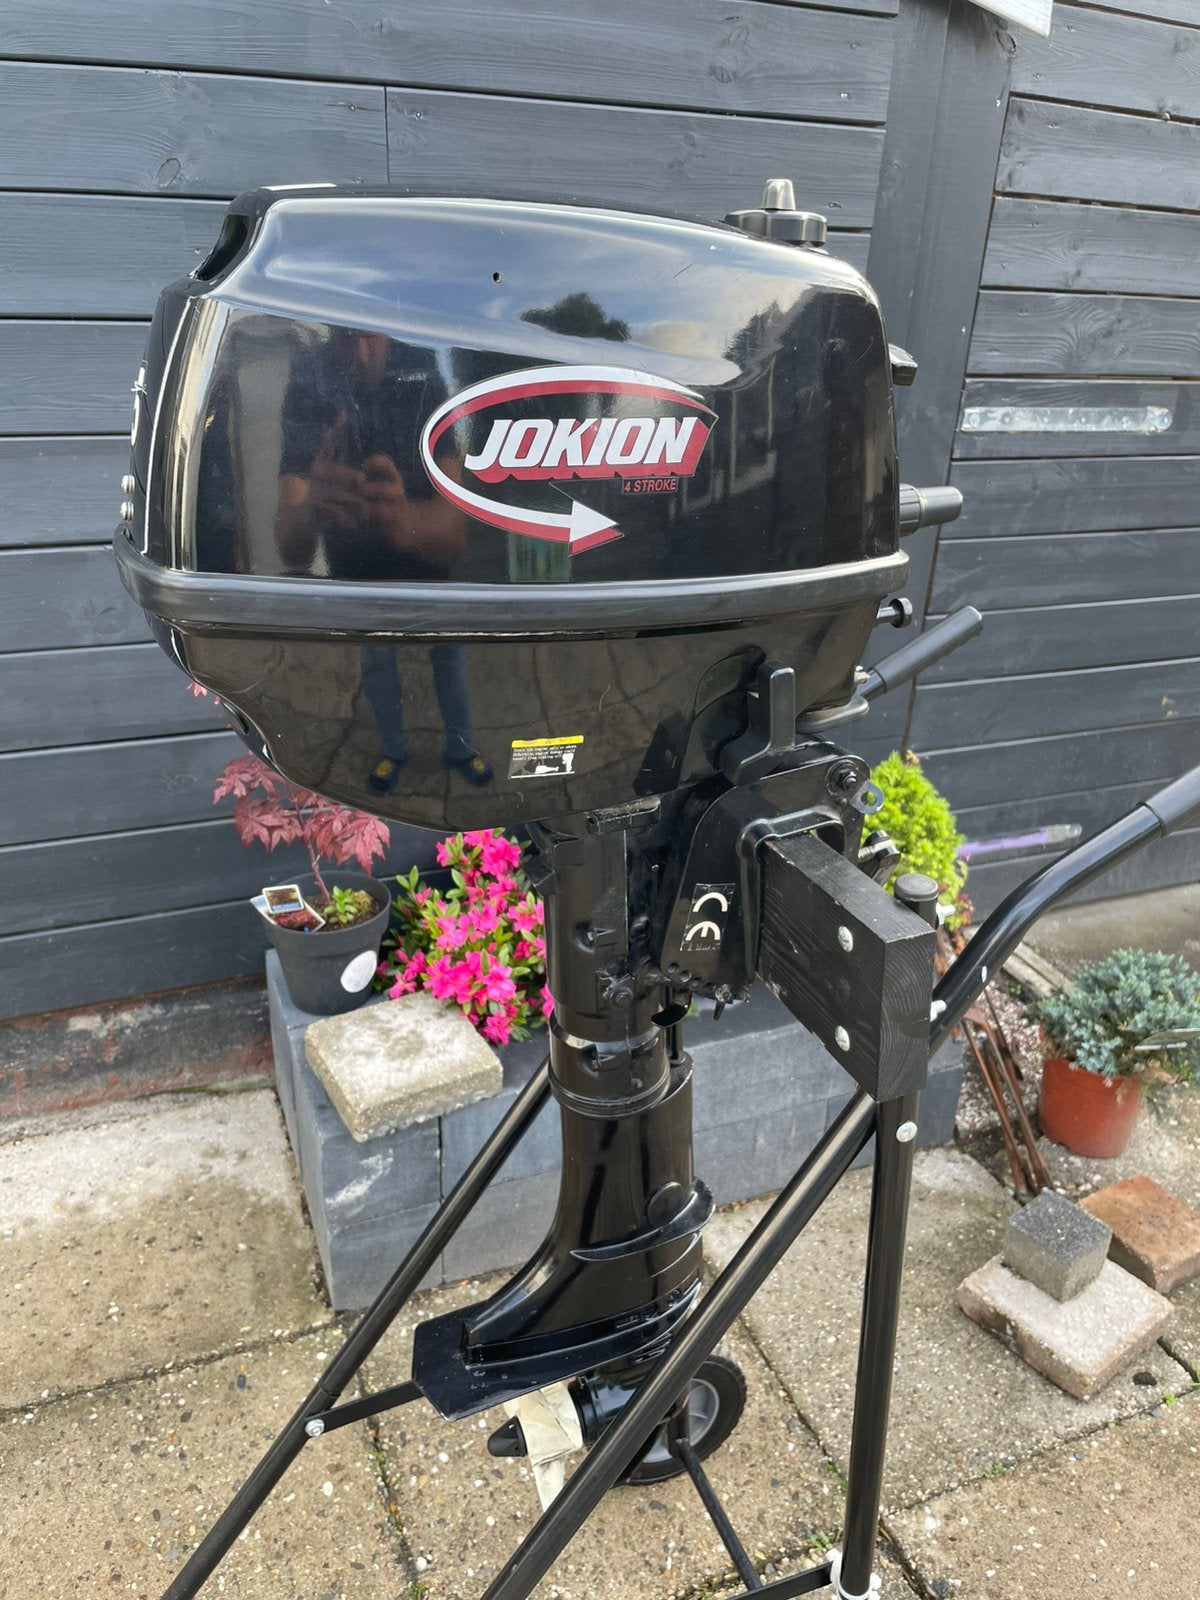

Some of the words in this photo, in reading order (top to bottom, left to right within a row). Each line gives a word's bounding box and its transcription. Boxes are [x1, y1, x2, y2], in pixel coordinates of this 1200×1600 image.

[464, 416, 700, 473] JOKION
[624, 481, 631, 493] 4
[633, 479, 677, 493] STROKE
